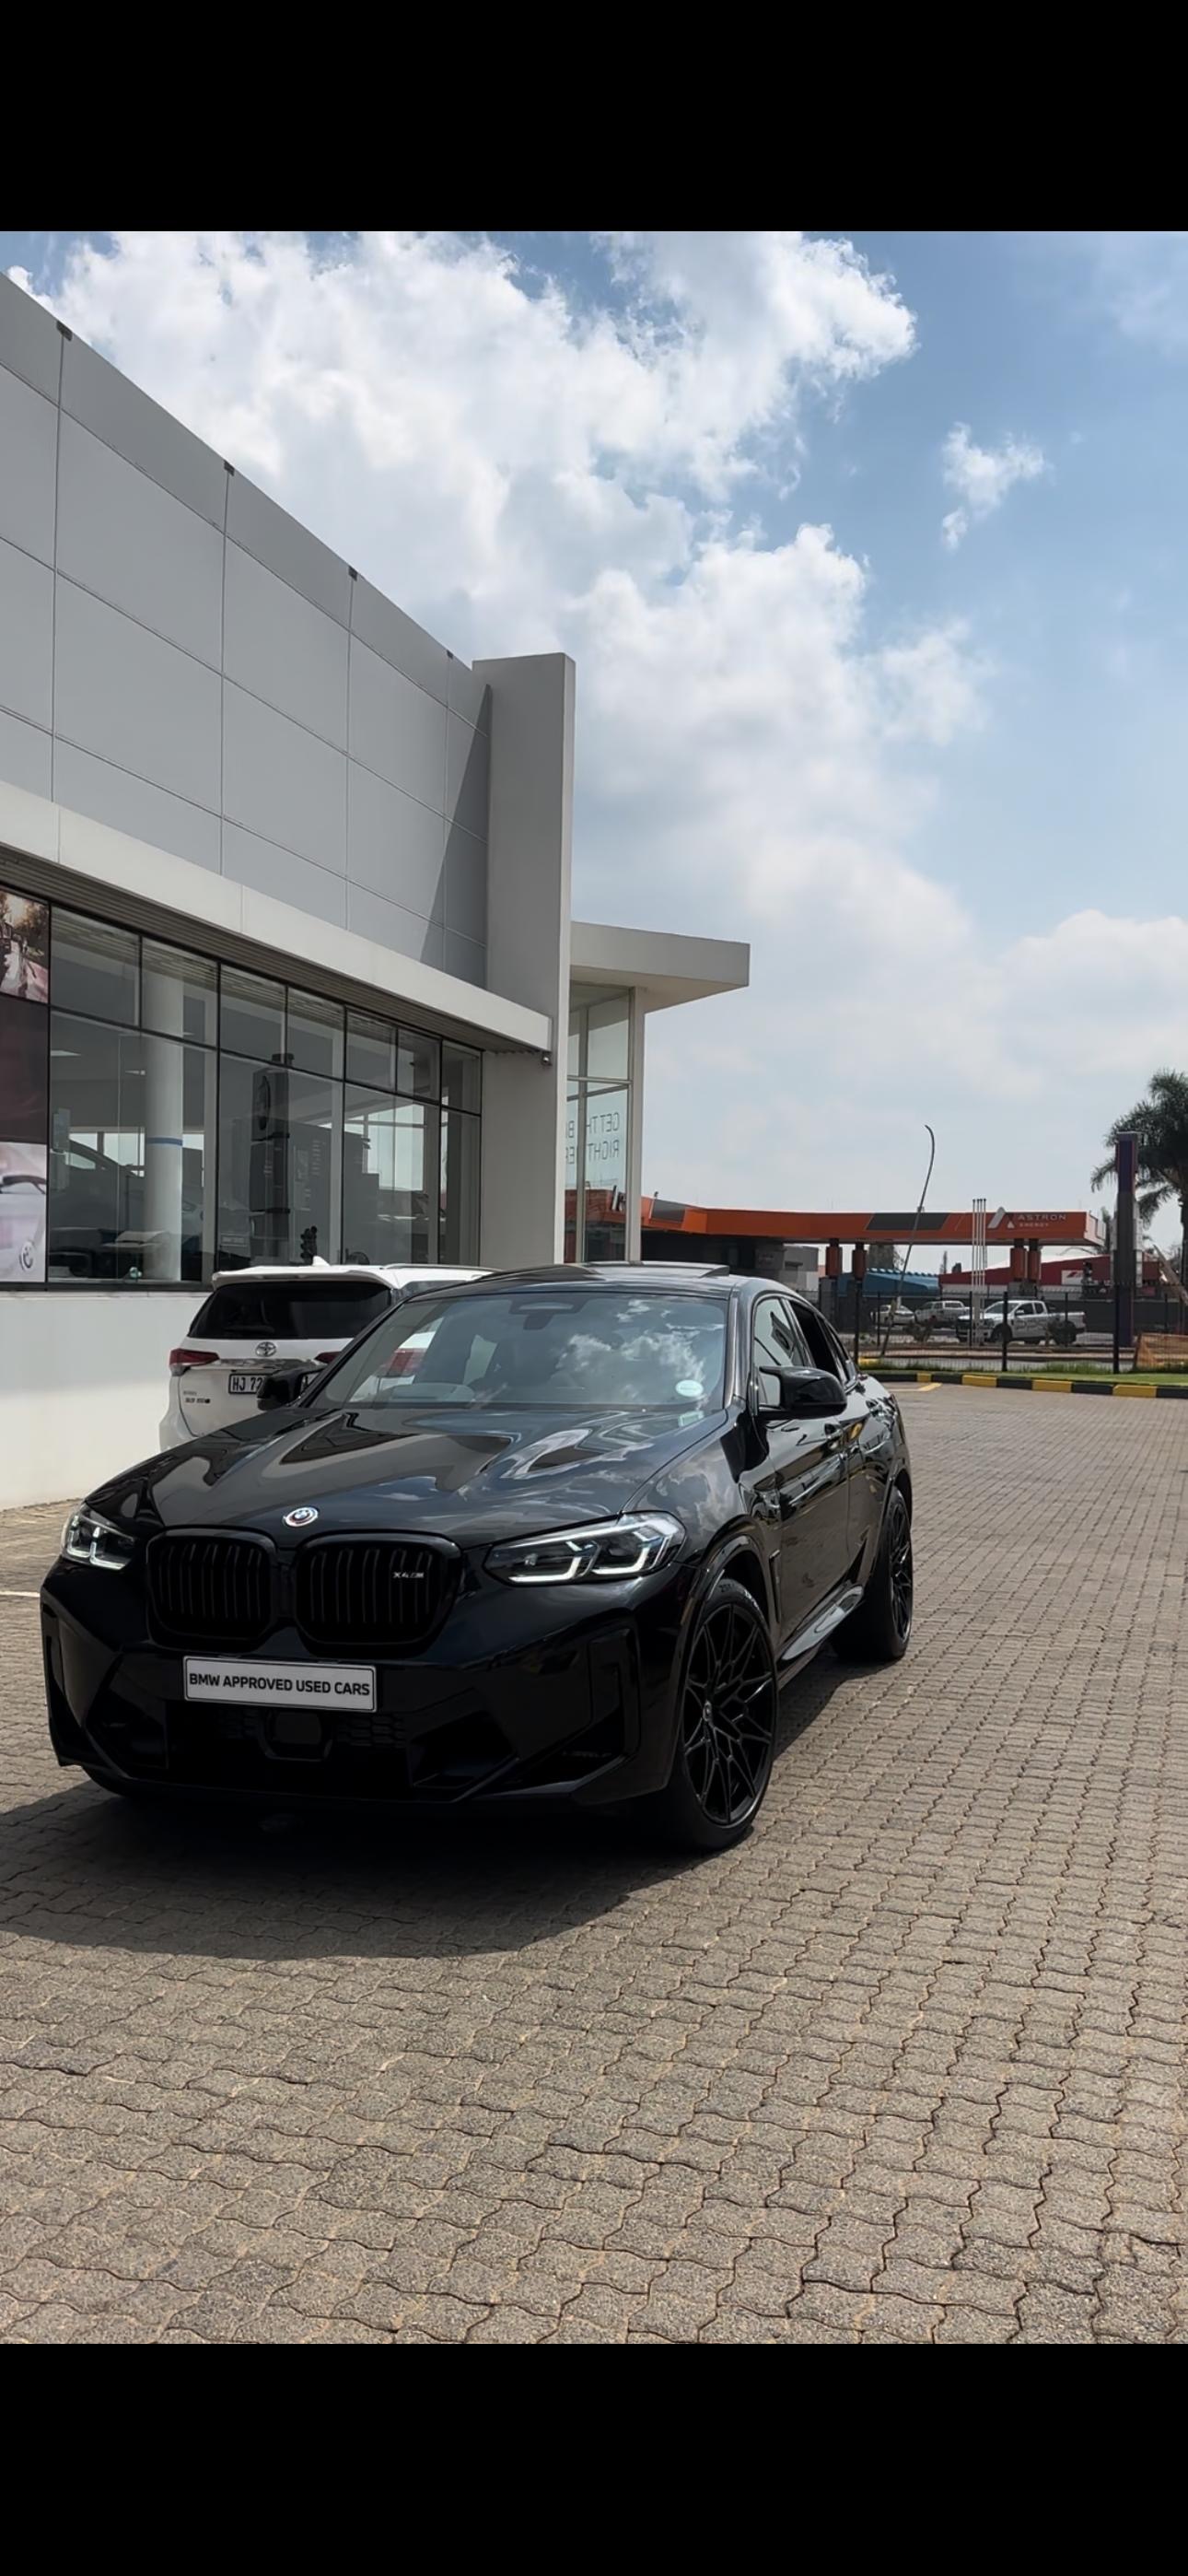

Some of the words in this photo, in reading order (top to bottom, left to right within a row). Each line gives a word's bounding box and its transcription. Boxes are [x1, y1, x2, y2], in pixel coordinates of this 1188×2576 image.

[1018, 1213, 1067, 1222] ASTRON
[232, 1376, 246, 1390] HJ
[189, 1673, 220, 1687] BMW
[223, 1675, 293, 1692] APPROVED
[296, 1680, 331, 1694] USED
[334, 1682, 370, 1696] CARS
